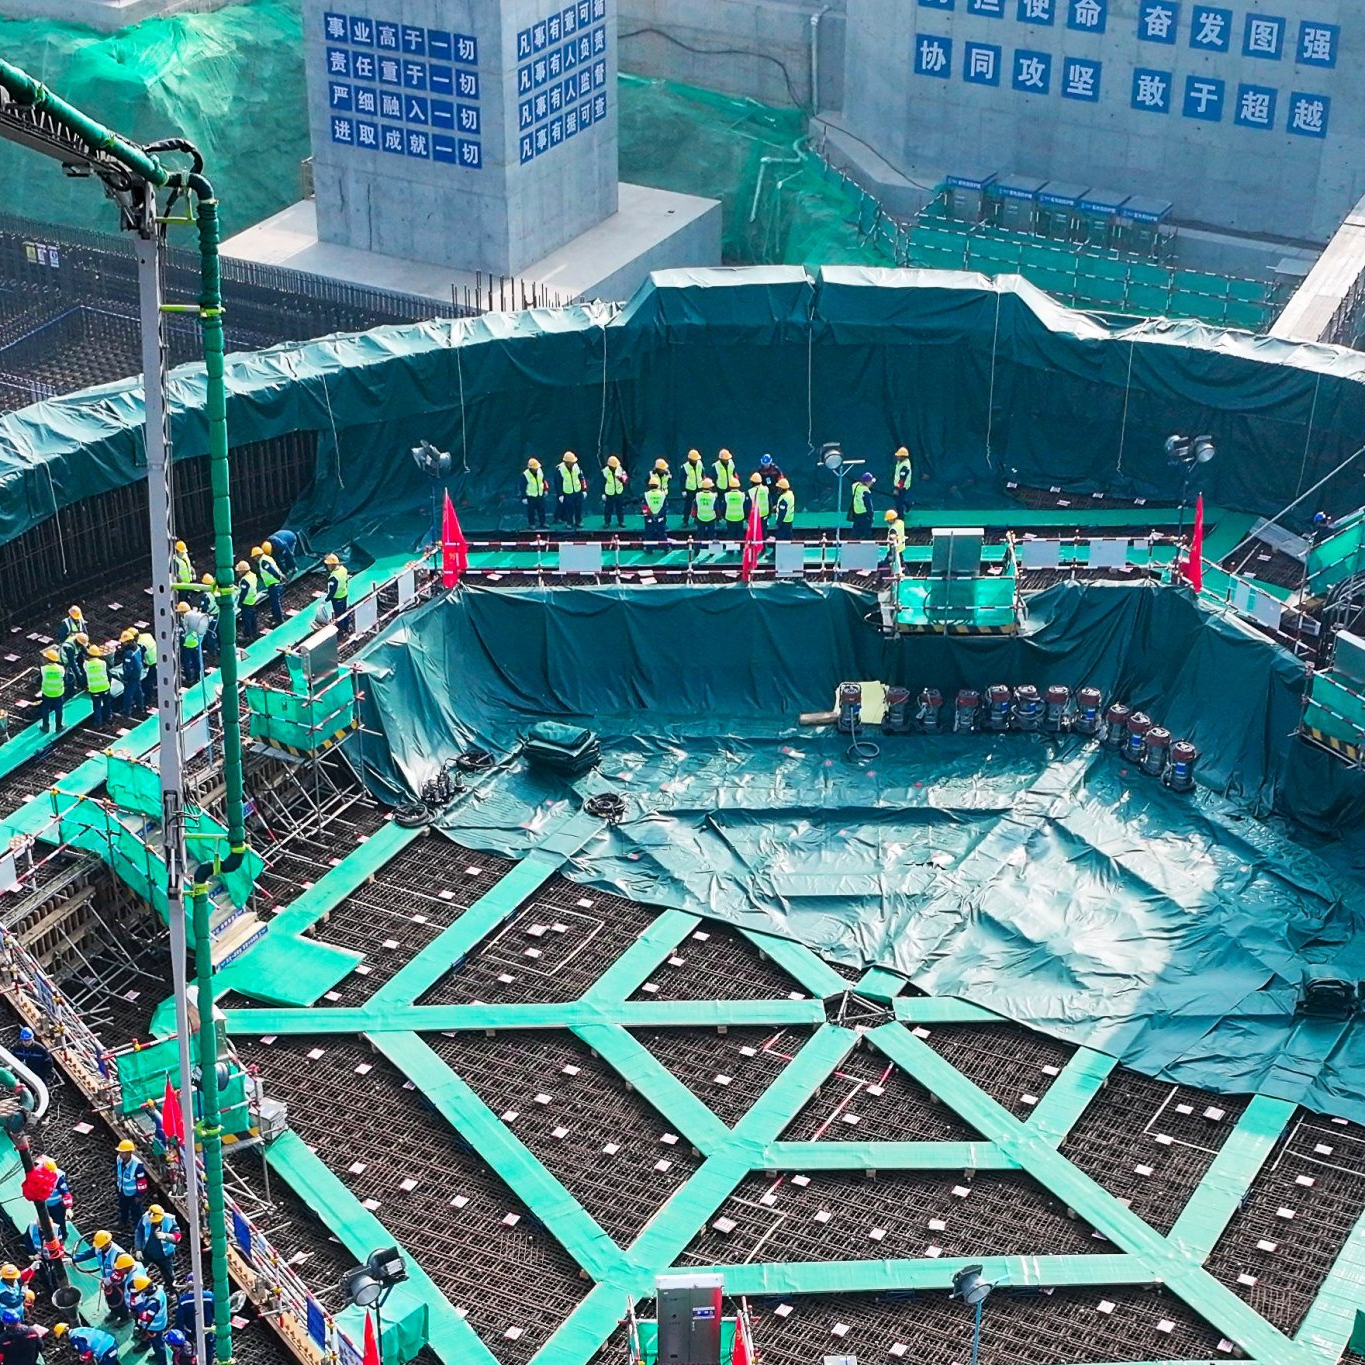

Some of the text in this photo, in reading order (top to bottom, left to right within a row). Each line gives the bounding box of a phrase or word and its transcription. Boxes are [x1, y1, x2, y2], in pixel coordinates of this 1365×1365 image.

[326, 15, 476, 61] 事业高于一切
[520, 29, 604, 91] 凡事有人负责
[927, 0, 1332, 62] 使命 奋发图强
[329, 51, 477, 96] 责任重于一切
[521, 63, 605, 126] 凡事有人监督
[920, 40, 1325, 132] 协同攻坚 敢于超越
[331, 86, 479, 130] 严细融入一切
[522, 97, 605, 160] 凡事有据可查
[334, 119, 480, 164] 进取成就一切
